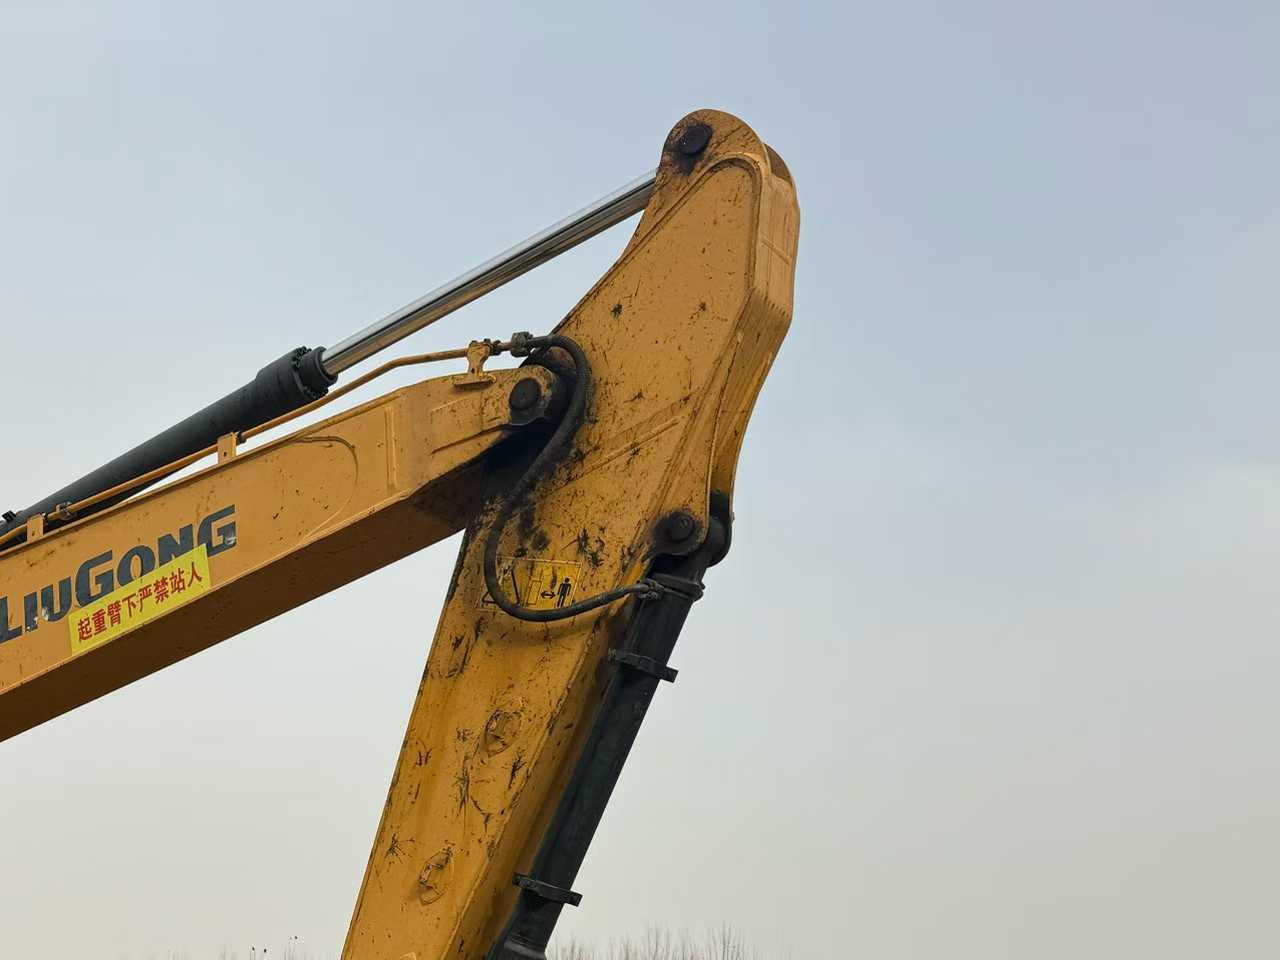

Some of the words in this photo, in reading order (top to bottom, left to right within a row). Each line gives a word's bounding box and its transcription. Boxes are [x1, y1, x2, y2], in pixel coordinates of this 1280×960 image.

[77, 560, 203, 643] 起重臂下严禁站人
